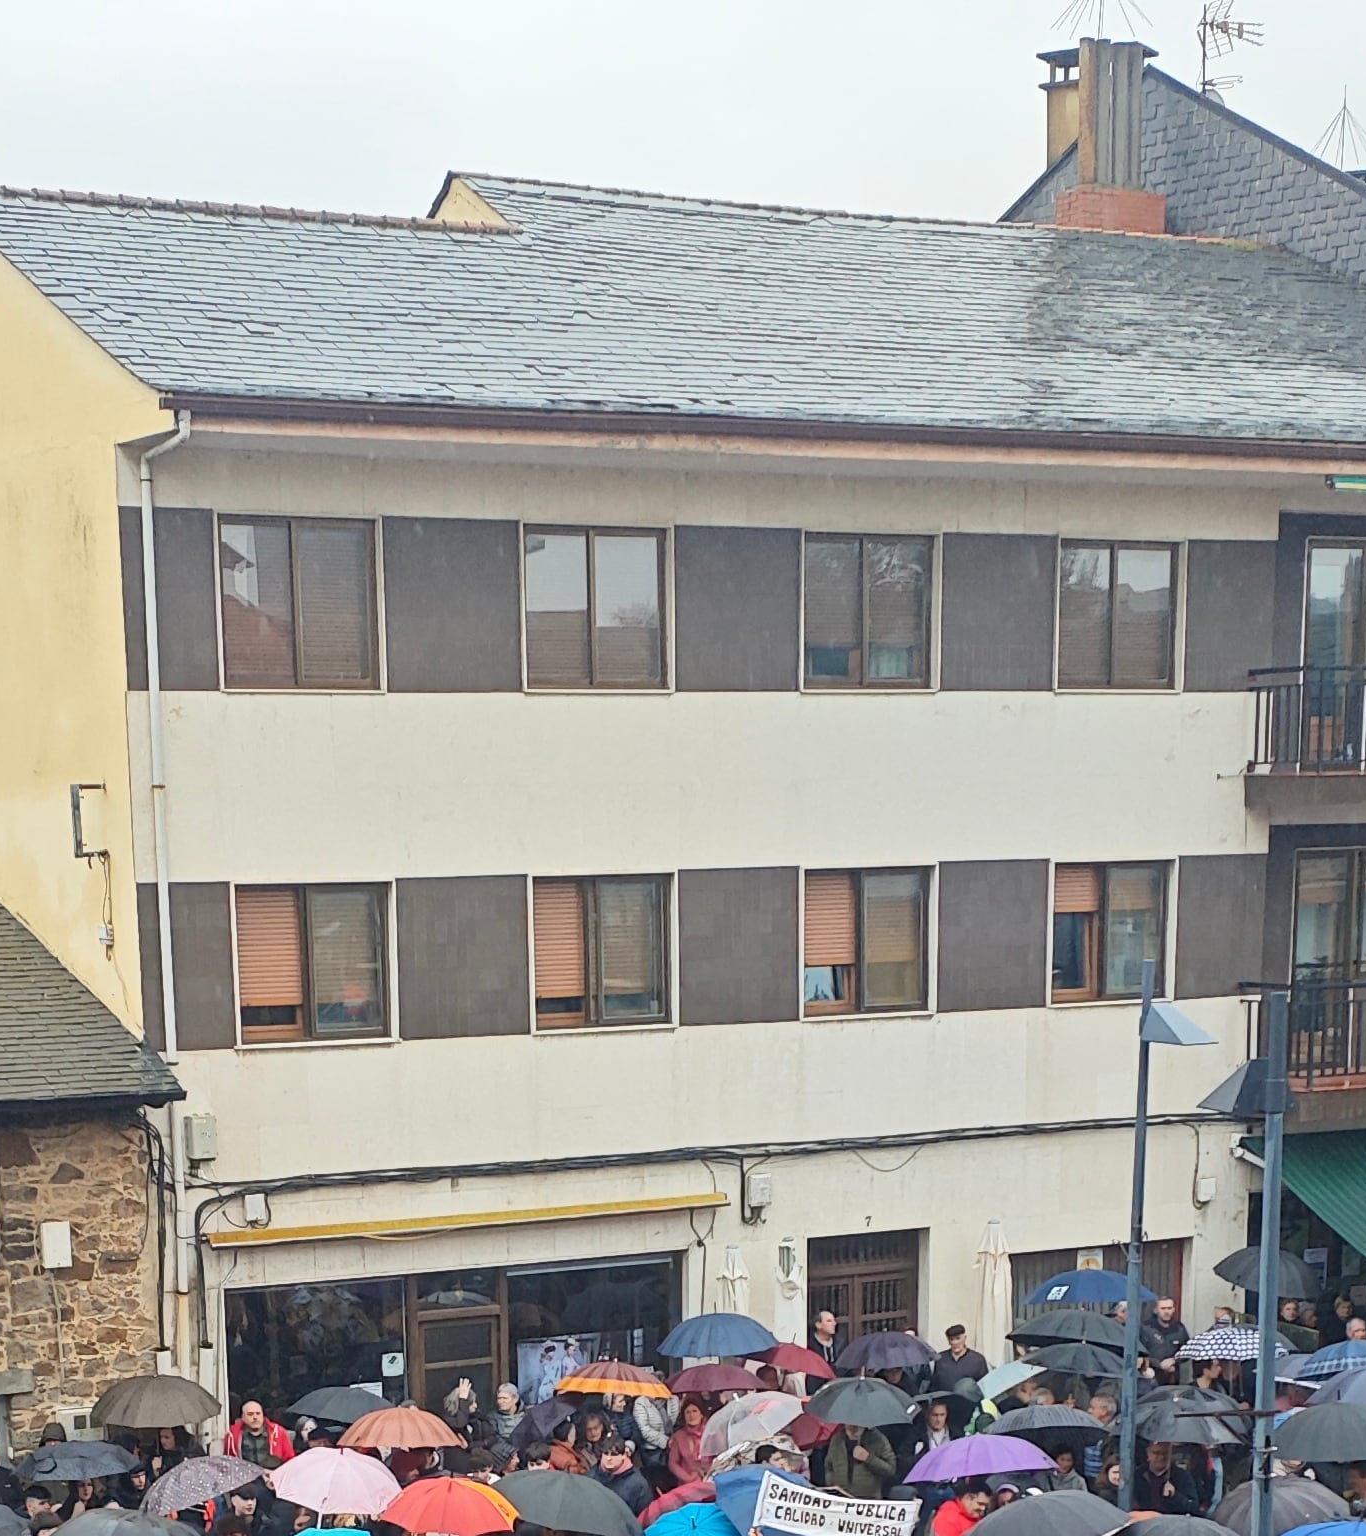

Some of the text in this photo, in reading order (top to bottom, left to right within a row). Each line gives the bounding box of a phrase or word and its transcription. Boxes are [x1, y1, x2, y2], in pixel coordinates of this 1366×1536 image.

[864, 1215, 873, 1228] 7
[768, 1483, 832, 1509] SANIDAD
[774, 1505, 826, 1528] CALIDAD
